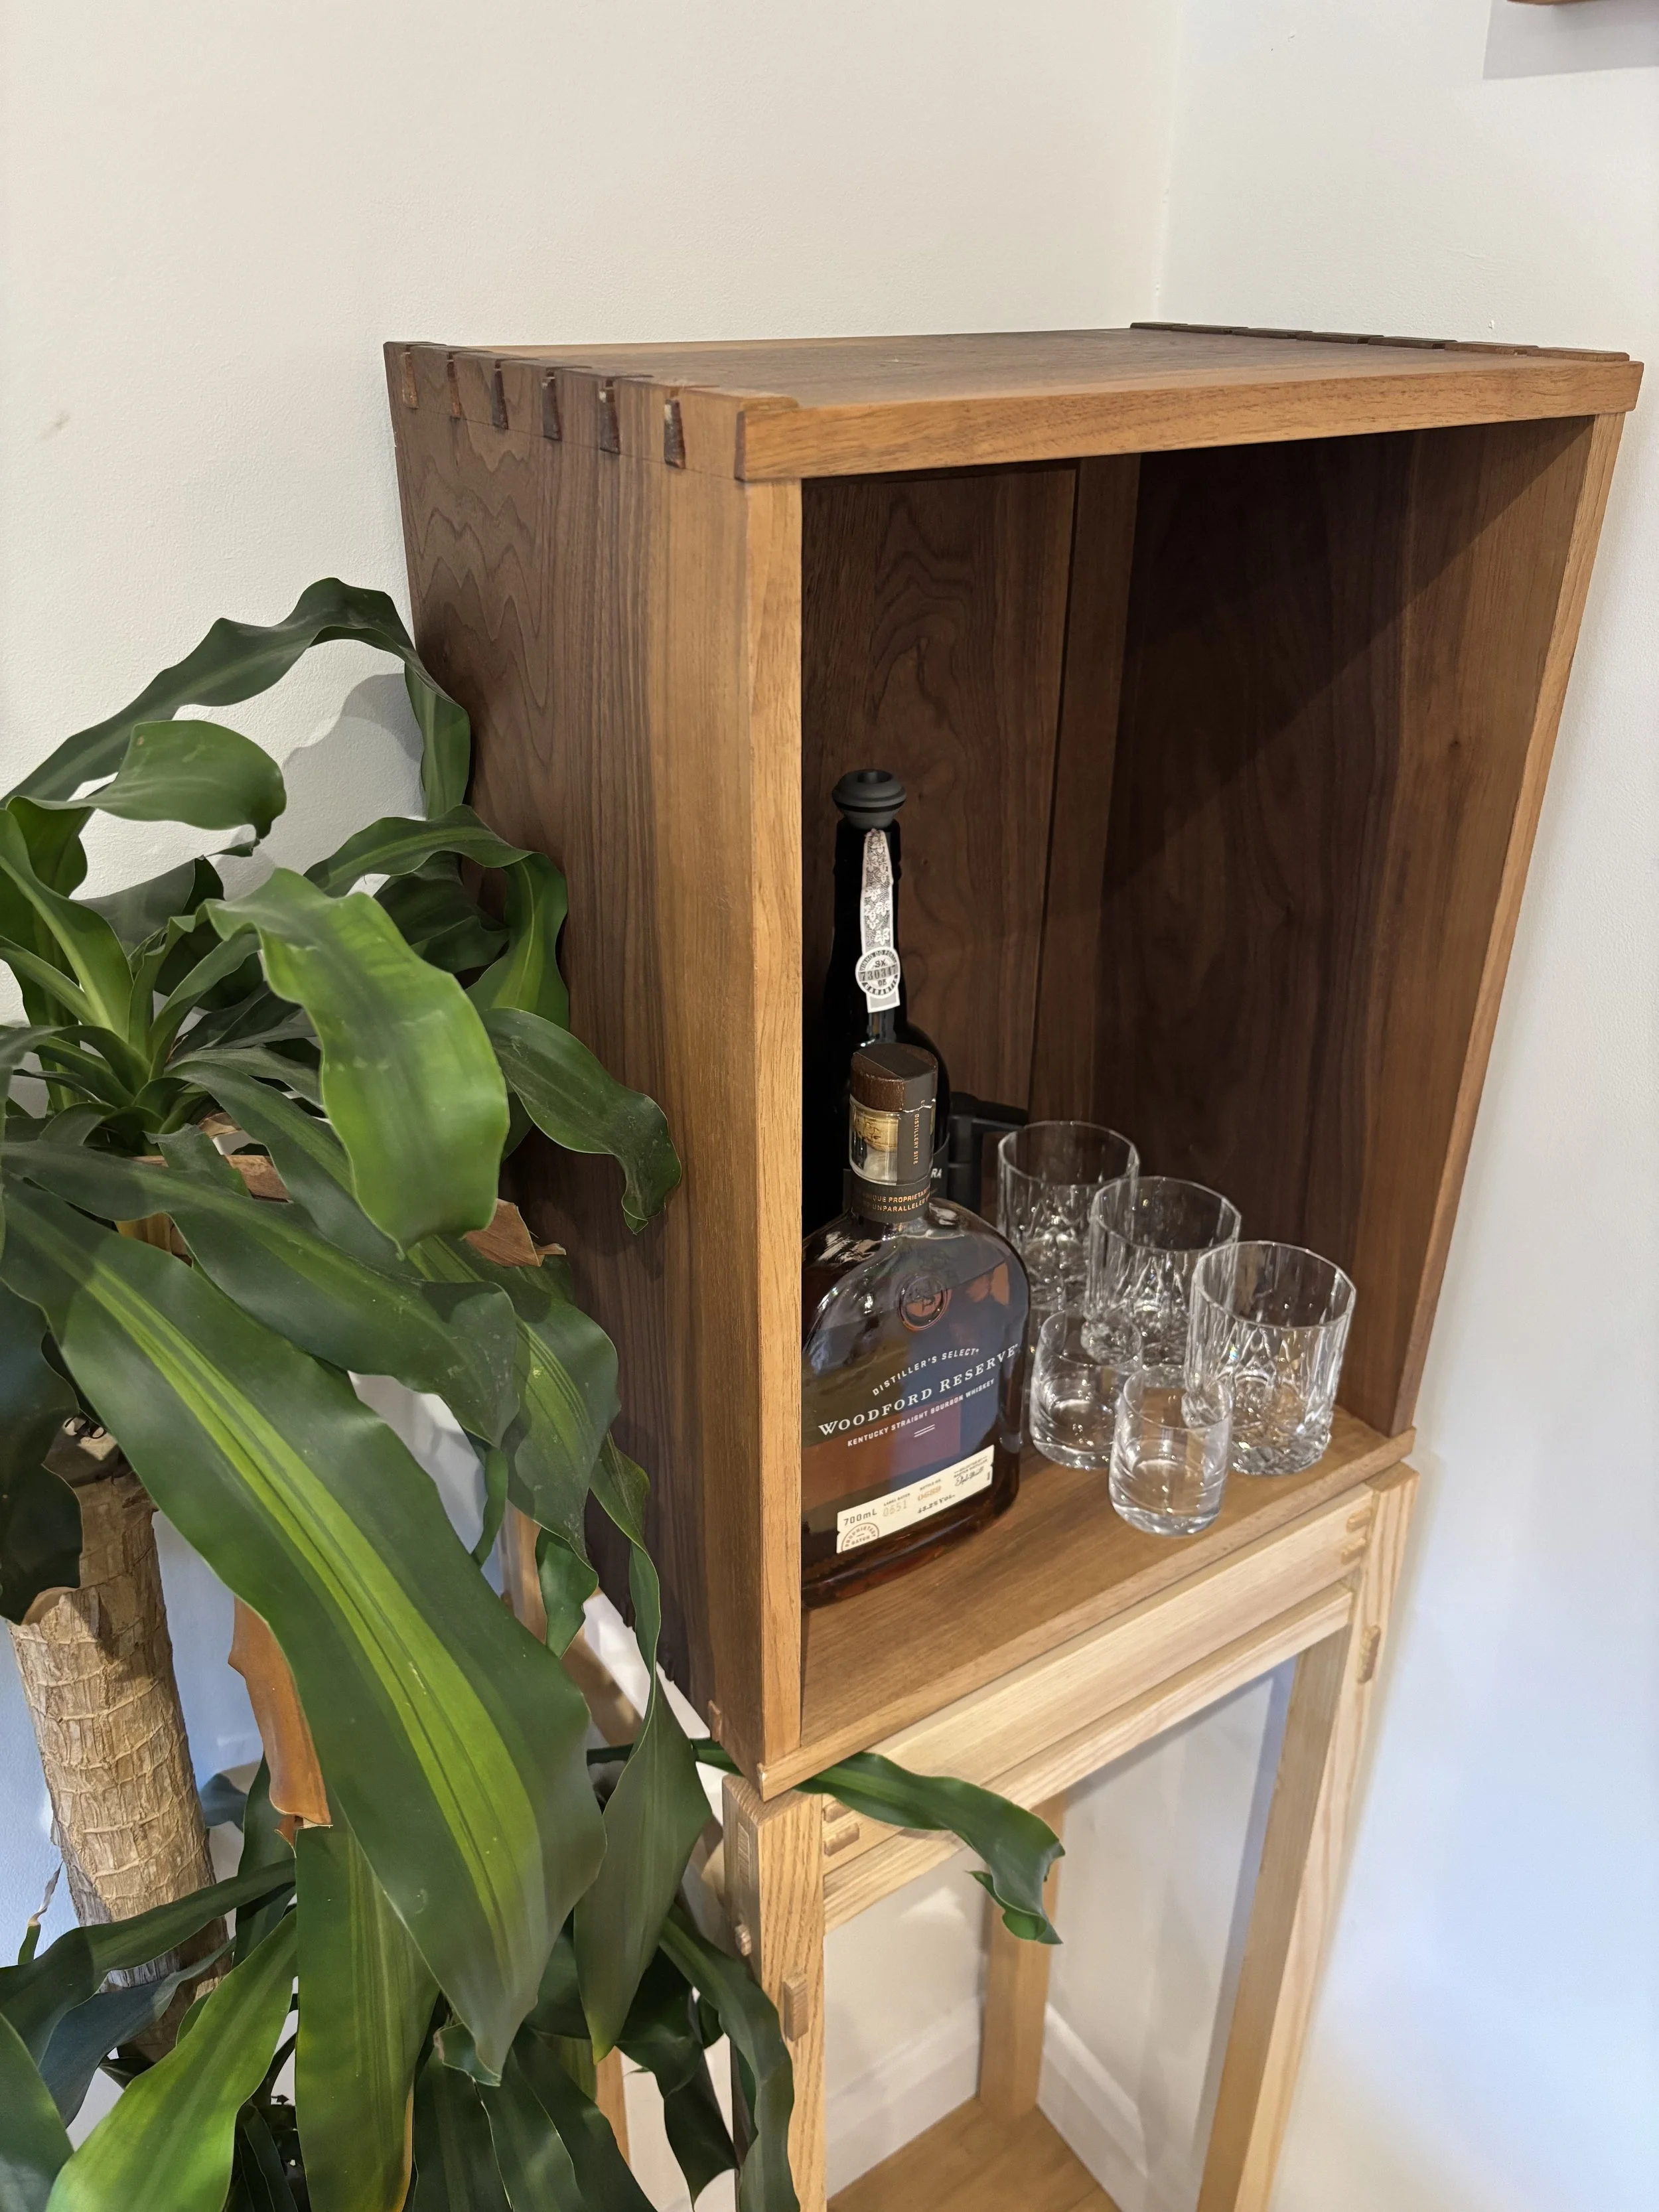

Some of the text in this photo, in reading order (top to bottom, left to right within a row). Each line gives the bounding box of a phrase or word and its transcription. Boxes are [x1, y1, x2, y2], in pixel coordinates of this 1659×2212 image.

[818, 1345, 1015, 1436] WOODFORD RESERVE
[872, 1355, 937, 1396] DISTILLER'S
[847, 1378, 995, 1447] KENTUCKY STRAIGHT BOURBON WHISKEY
[843, 1509, 878, 1526] 700mL
